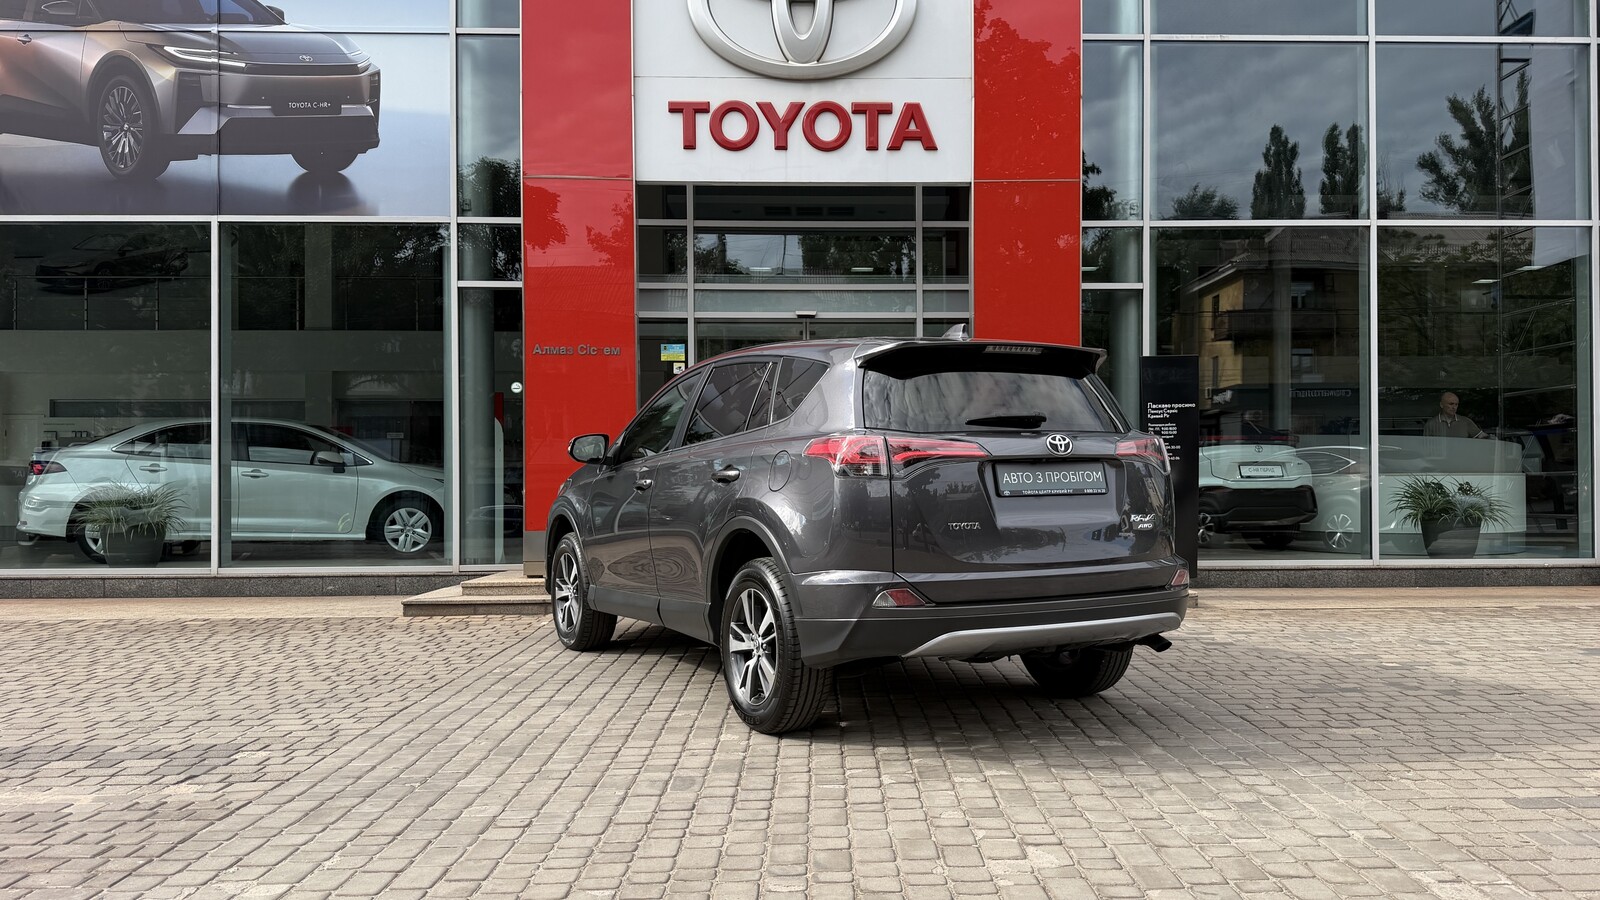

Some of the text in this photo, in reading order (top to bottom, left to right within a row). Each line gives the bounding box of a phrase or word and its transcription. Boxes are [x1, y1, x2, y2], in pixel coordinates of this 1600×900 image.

[668, 100, 938, 152] TOYOTA
[532, 344, 620, 355] Алмаз Сісем
[1003, 471, 1103, 484] АВТО З ПРОБІГОМ
[948, 522, 981, 530] TOYOTA
